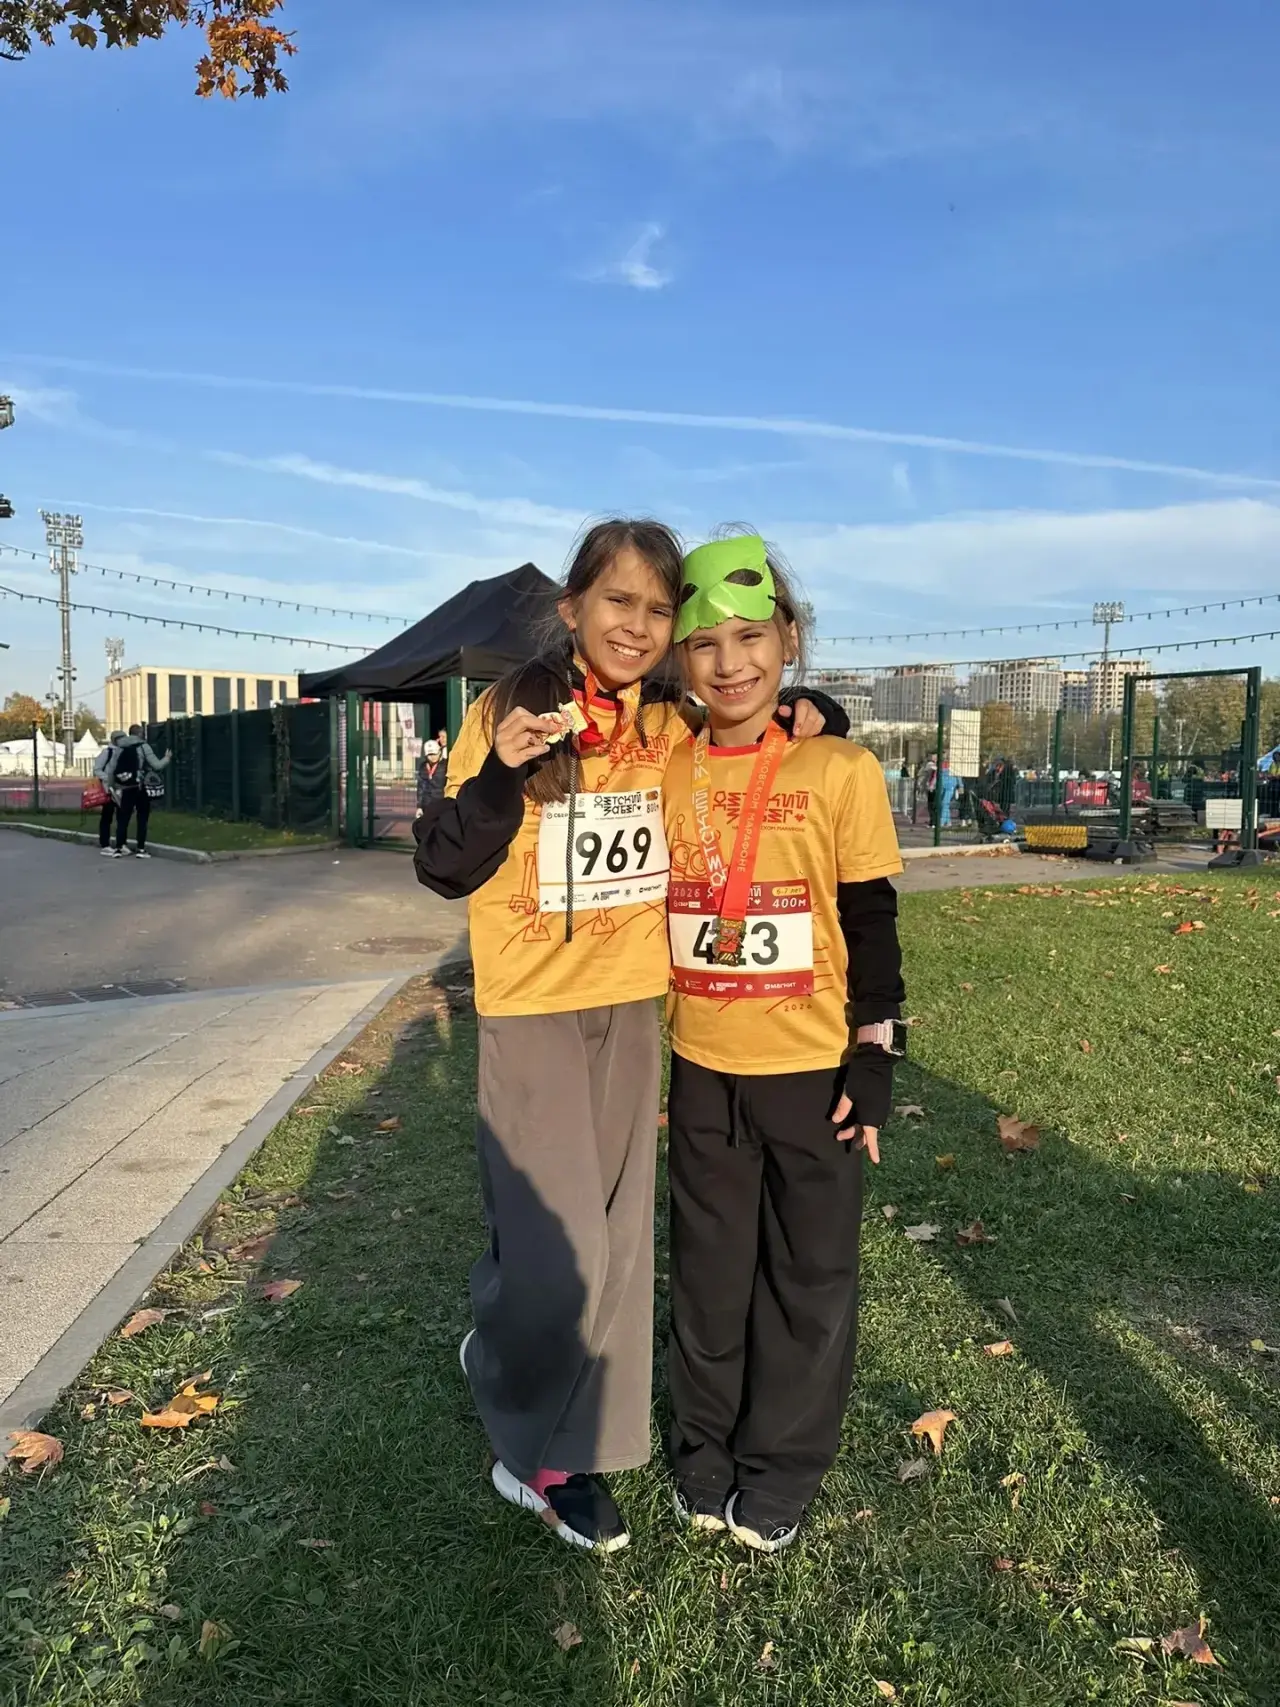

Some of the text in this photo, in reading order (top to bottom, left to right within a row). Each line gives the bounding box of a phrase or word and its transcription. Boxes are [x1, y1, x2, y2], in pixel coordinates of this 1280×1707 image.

[594, 792, 642, 808] ДЕТСКИЙ
[603, 804, 636, 817] ЗАБЕГ
[712, 790, 810, 811] ДЕКИЙ
[575, 826, 652, 876] 969
[737, 812, 756, 873] МАРАФОНЕ
[673, 887, 701, 898] 2026
[693, 921, 779, 966] 43
